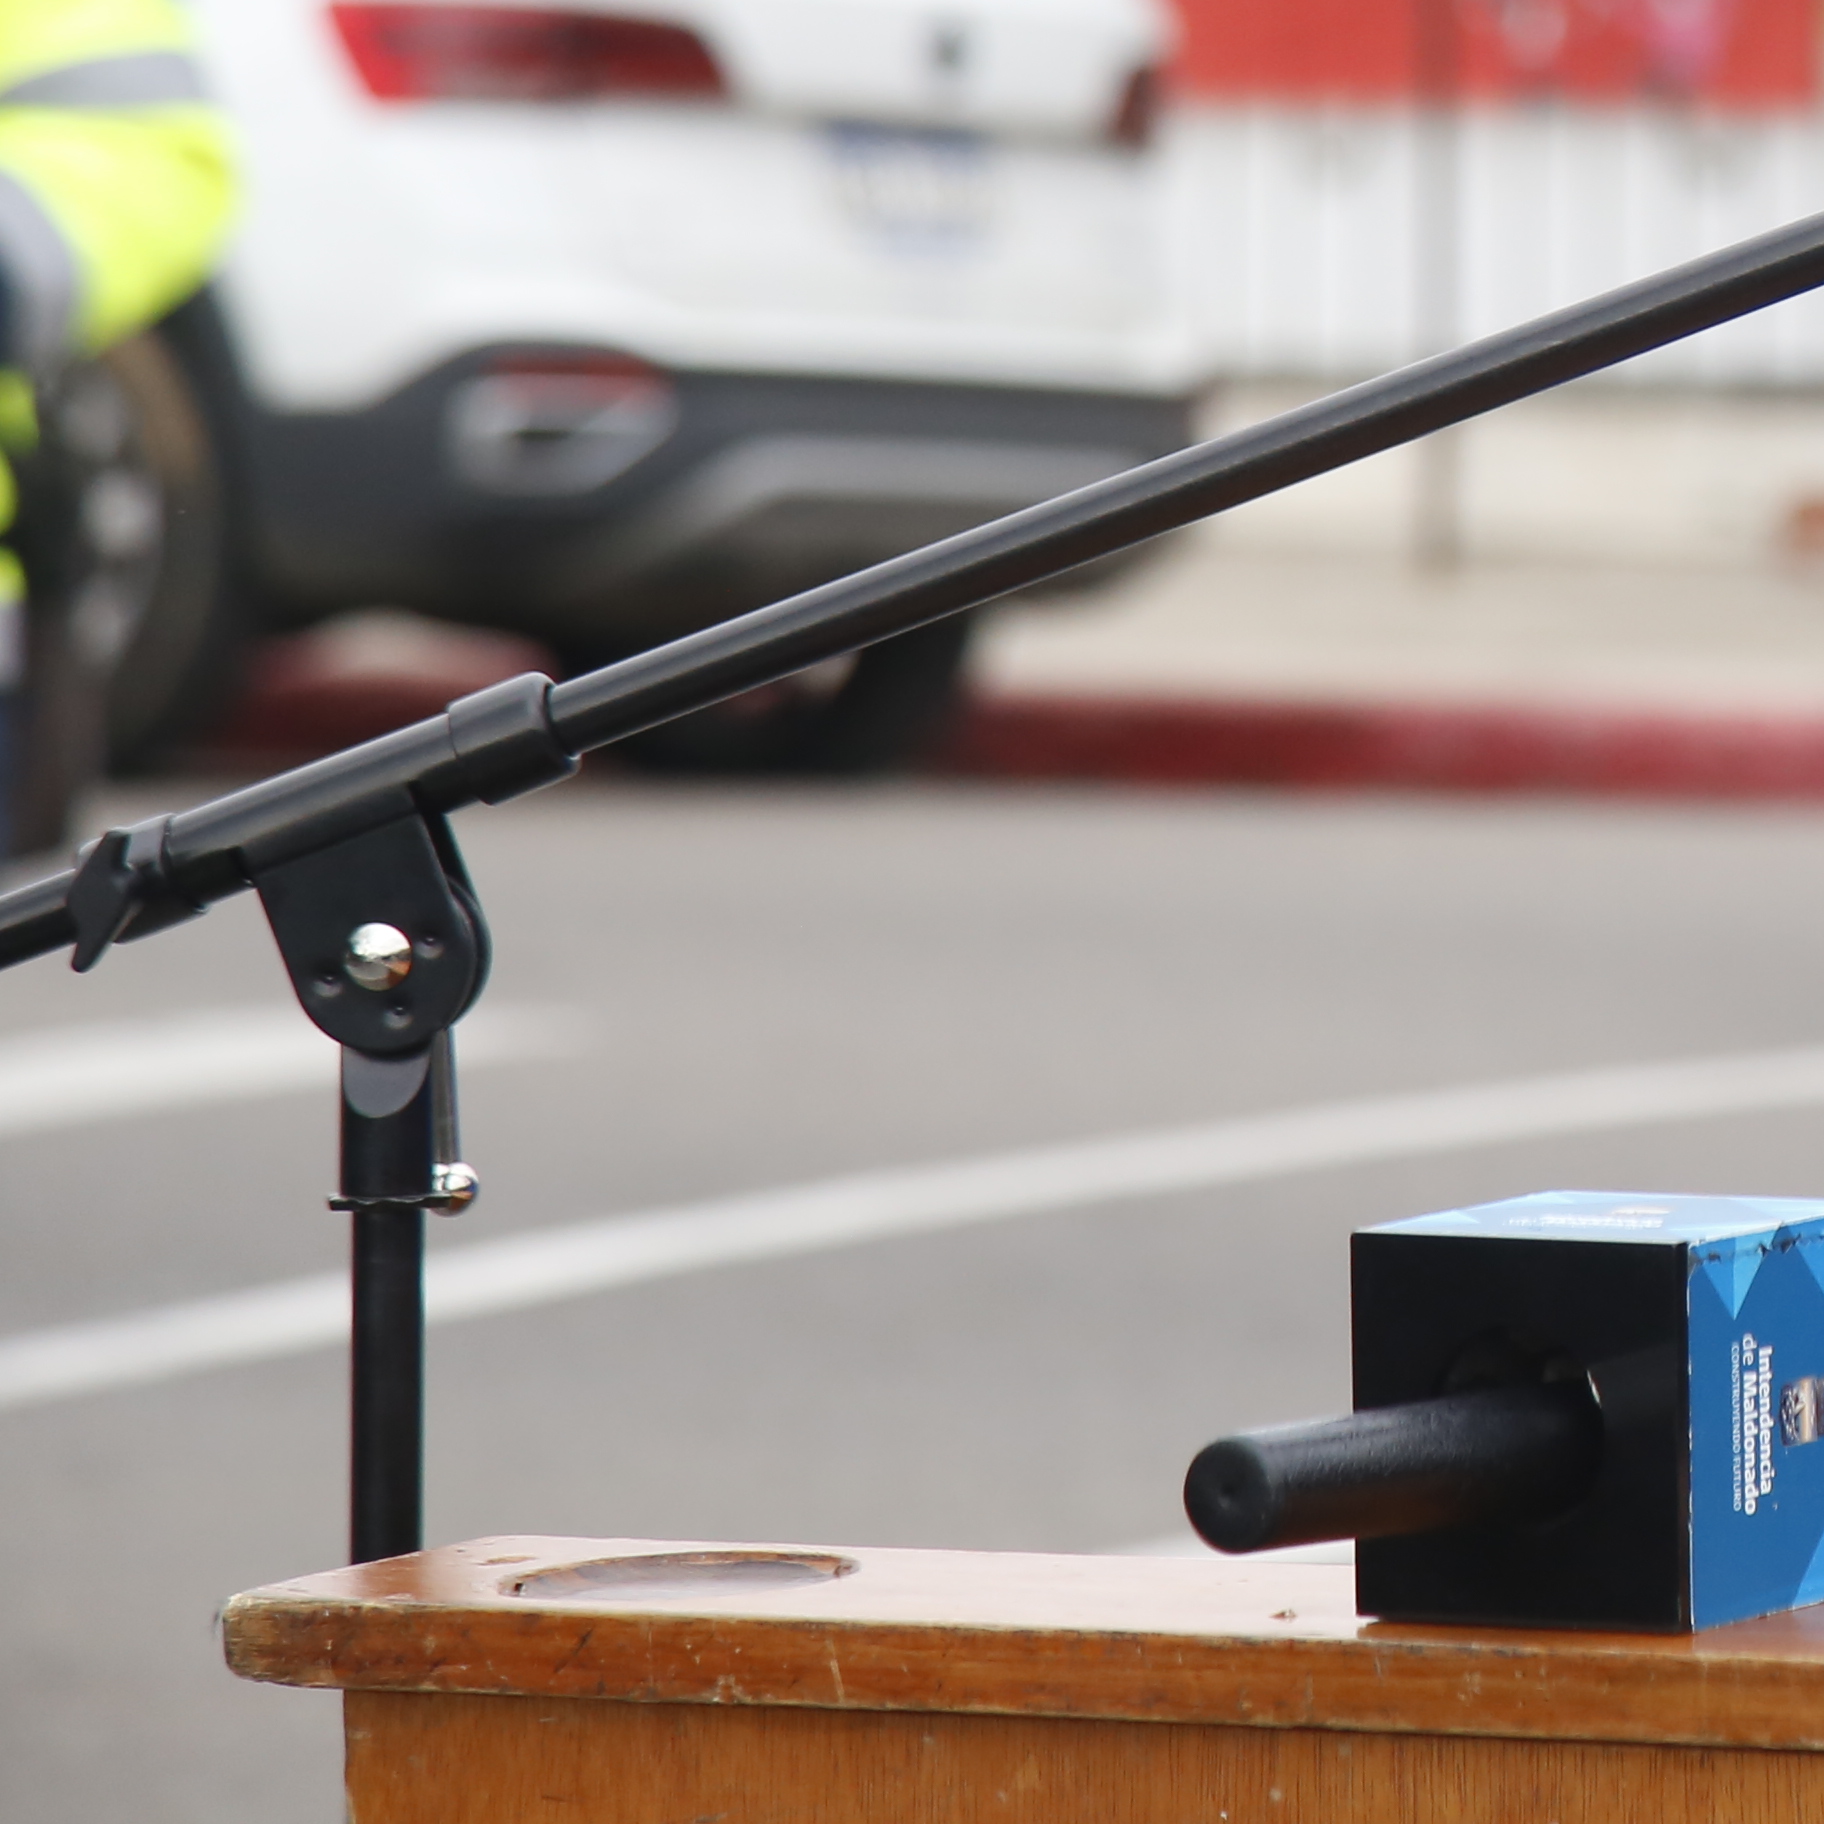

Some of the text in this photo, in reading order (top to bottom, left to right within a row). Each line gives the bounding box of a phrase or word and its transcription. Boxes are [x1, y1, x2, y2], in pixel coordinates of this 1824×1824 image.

[1731, 1342, 1742, 1512] CONSTRUYENDO FUTURO
[1743, 1332, 1759, 1516] de Maldonado
[1759, 1345, 1776, 1495] Intendencia
